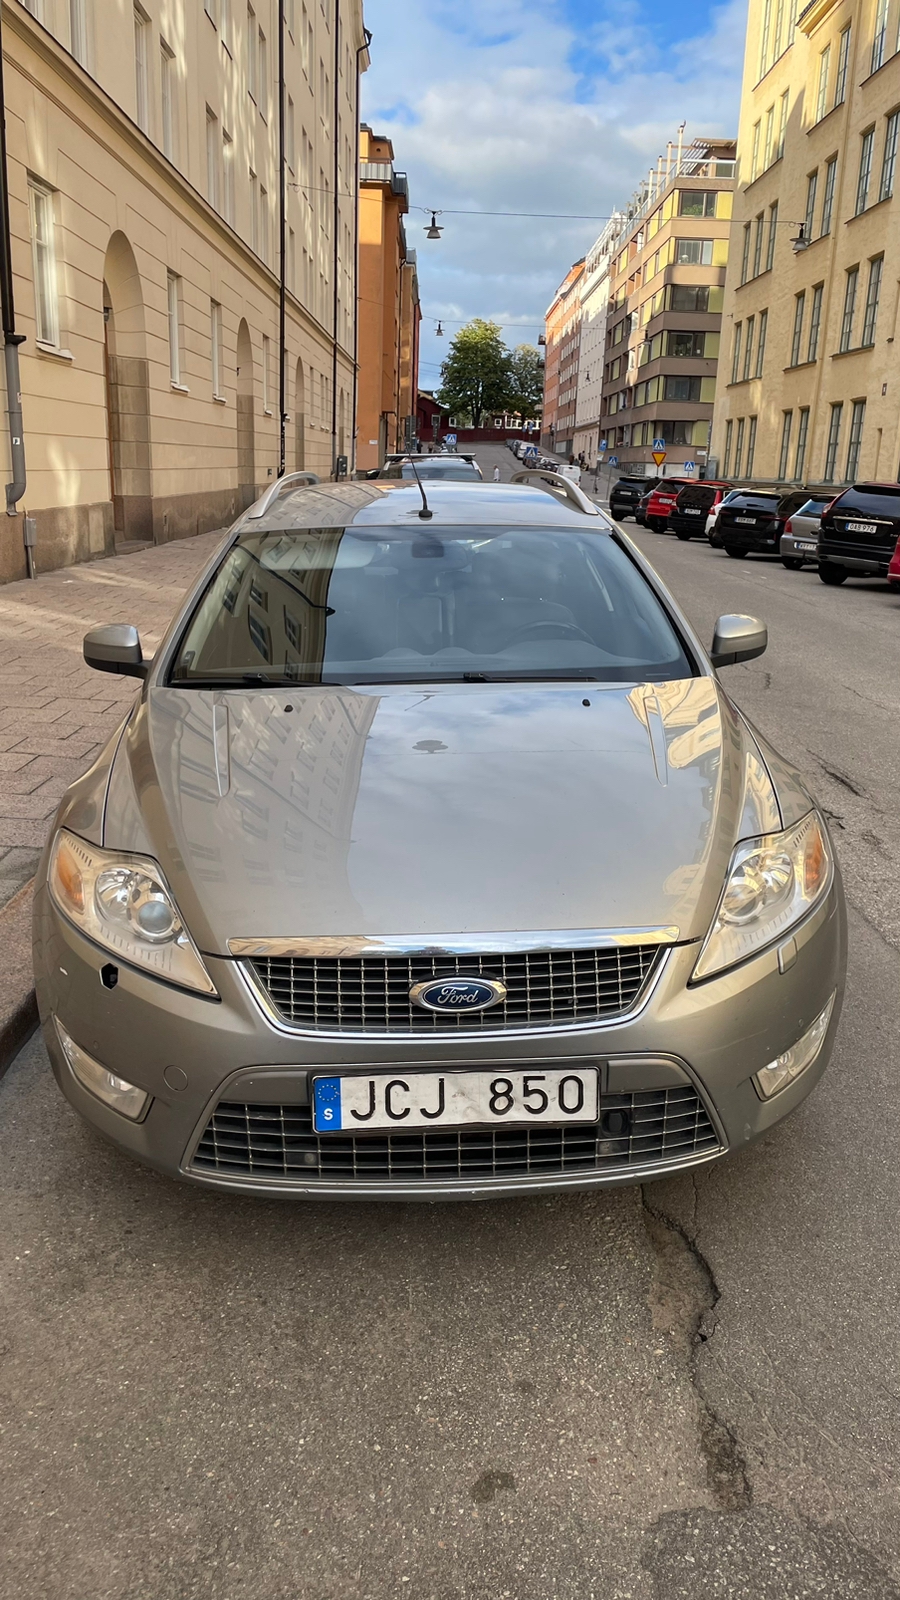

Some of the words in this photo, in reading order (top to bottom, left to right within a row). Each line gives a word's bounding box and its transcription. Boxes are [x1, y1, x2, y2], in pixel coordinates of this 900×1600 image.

[437, 986, 478, 1004] Ford
[323, 1108, 333, 1121] S
[350, 1077, 446, 1121] JCJ
[488, 1075, 585, 1116] 850
